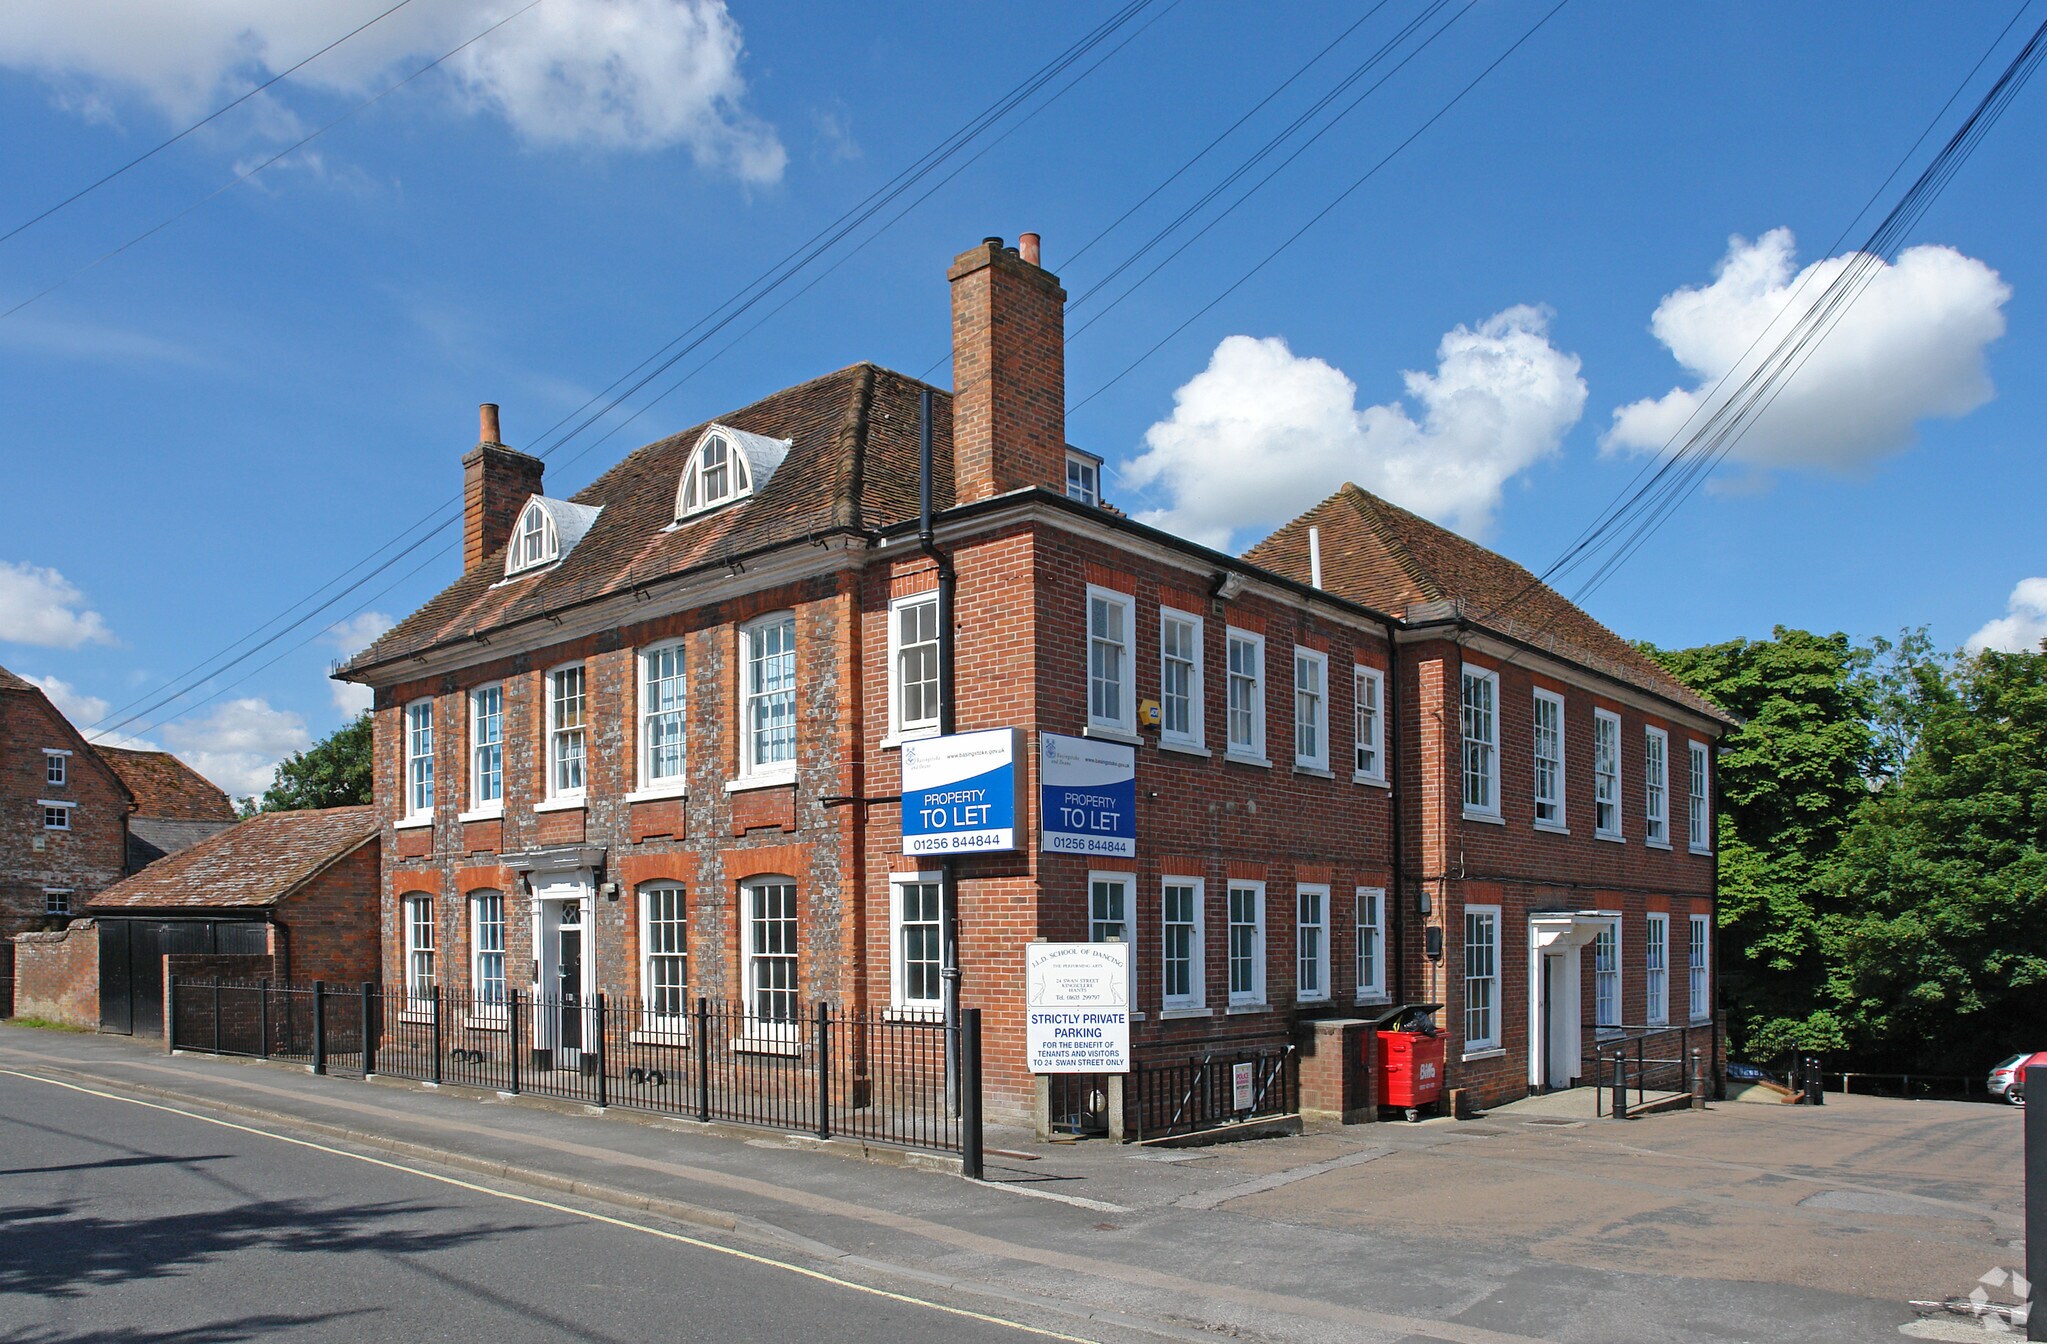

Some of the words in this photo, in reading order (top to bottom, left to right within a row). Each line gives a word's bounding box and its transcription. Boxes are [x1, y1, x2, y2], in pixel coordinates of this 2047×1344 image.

[924, 788, 986, 806] PROPERTY
[1064, 792, 1117, 809] PROPERTY
[919, 808, 947, 829] TO
[953, 804, 992, 827] LET
[1060, 807, 1085, 828] TO
[1090, 810, 1121, 832] LET
[914, 838, 949, 851] 01256
[952, 834, 1000, 848] 844844
[1053, 836, 1085, 850] 01256
[1088, 839, 1127, 853] 844844
[1049, 948, 1078, 959] SCHOOL
[1093, 950, 1125, 968] DANCING
[1031, 1014, 1080, 1024] STRICTLY
[1083, 1014, 1125, 1024] PRIVATE
[1054, 1028, 1102, 1038] PARKING
[1037, 1050, 1070, 1058] TENANTS
